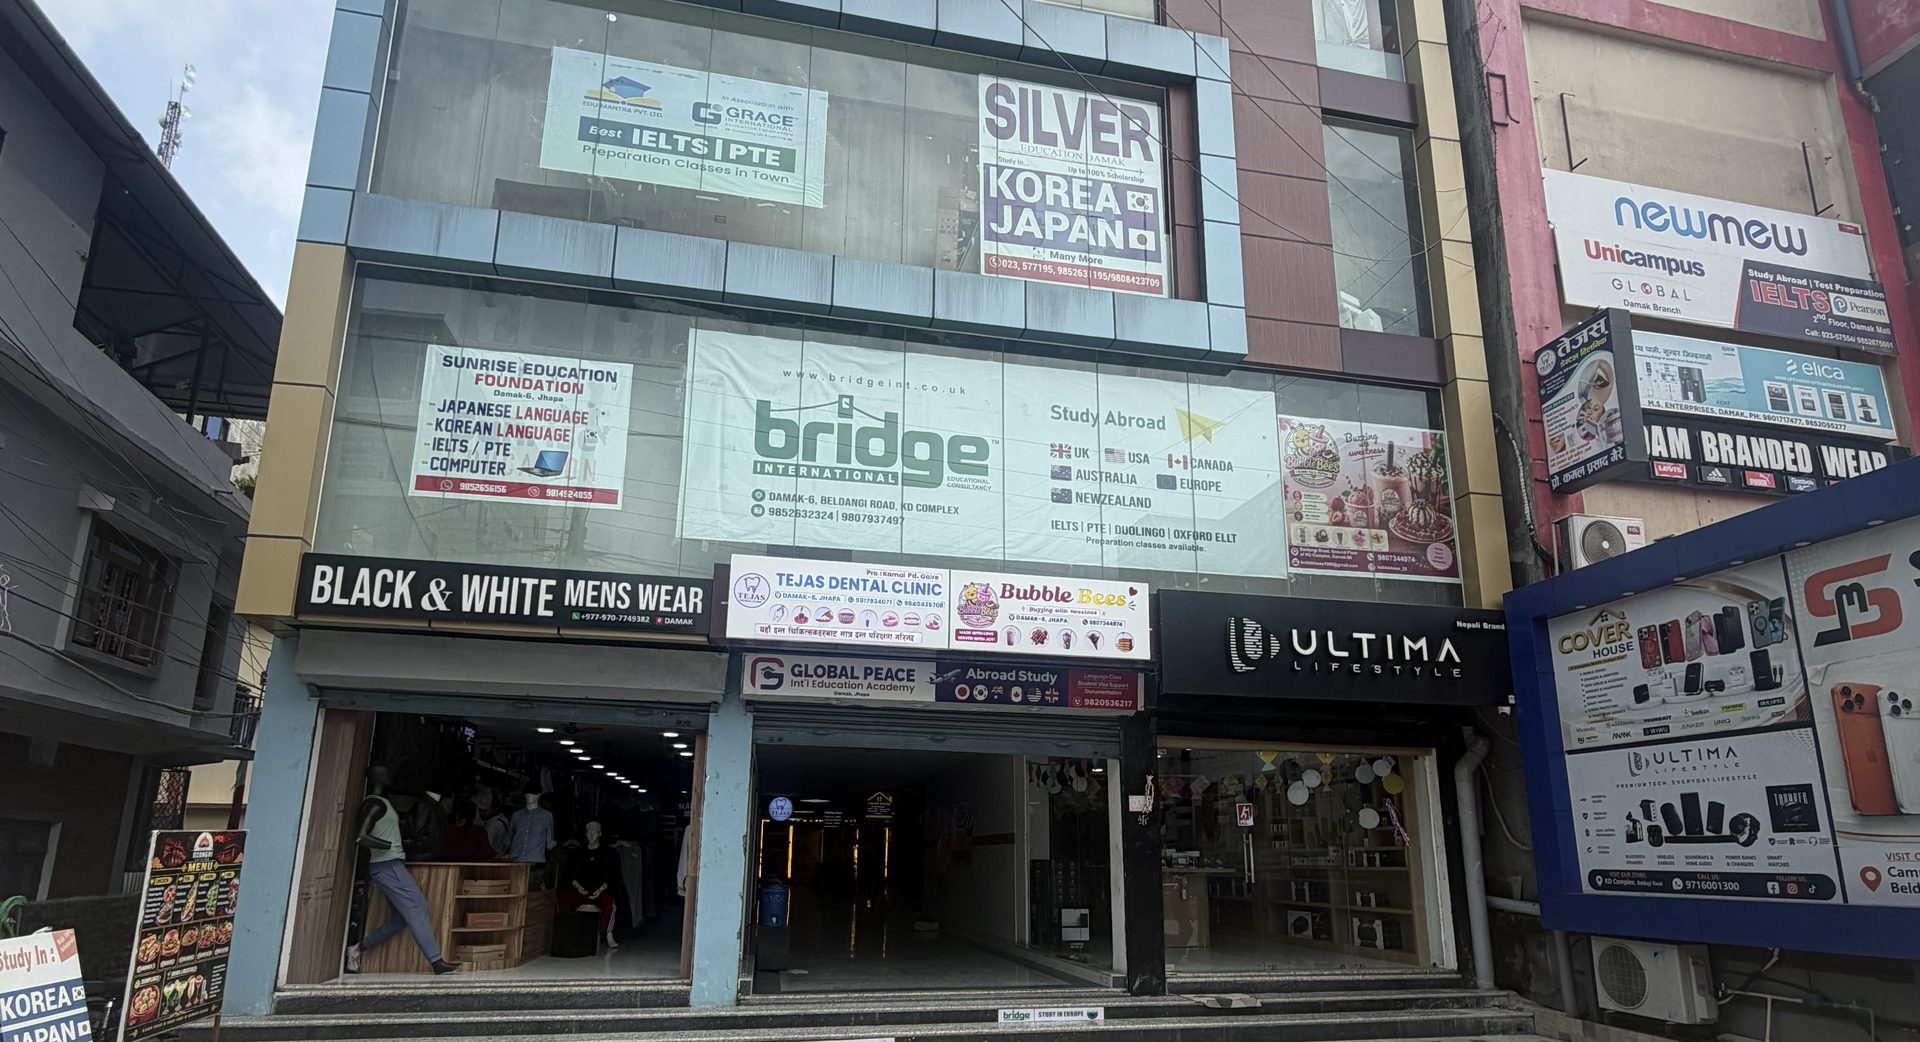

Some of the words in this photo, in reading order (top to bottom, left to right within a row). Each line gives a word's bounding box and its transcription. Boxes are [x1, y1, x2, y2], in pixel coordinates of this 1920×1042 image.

[731, 97, 776, 108] Association
[778, 103, 794, 111] with
[725, 117, 793, 132] INTERNATIONAL
[726, 106, 794, 127] GRACE
[985, 82, 1154, 162] SILVER
[589, 125, 623, 139] Best
[632, 128, 708, 155] IELTS
[729, 146, 780, 167] PTE
[1020, 143, 1083, 160] EDUCATION
[582, 144, 671, 167] Preparation
[675, 158, 732, 175] Classes
[735, 166, 748, 178] in
[752, 169, 790, 184] Town
[998, 156, 1016, 165] Study
[1068, 166, 1077, 175] Up
[1087, 168, 1105, 178] 100%
[1106, 171, 1145, 183] Scholarship
[989, 166, 1122, 215] KOREA
[989, 204, 1125, 250] JAPAN
[1614, 196, 1808, 257] newmew
[1001, 258, 1020, 270] 023,
[1022, 262, 1056, 275] 577195,
[1050, 250, 1076, 264] Many
[1078, 253, 1103, 266] More
[1584, 238, 1706, 277] Unicampus
[1611, 278, 1692, 301] GLOBAL
[1748, 268, 1774, 283] Study
[1776, 273, 1808, 287] Abroad
[1813, 280, 1834, 291] Test
[1835, 284, 1886, 299] Preparation
[1623, 299, 1651, 311] Damak
[1652, 303, 1682, 315] Branch
[1749, 279, 1831, 314] IELTS
[1850, 302, 1886, 317] Pearson
[1828, 317, 1850, 329] Floor,
[1850, 321, 1875, 333] Damak
[442, 355, 517, 373] SUNRISE
[523, 363, 618, 383] EDUCATION
[1801, 361, 1845, 380] elica
[475, 373, 584, 394] FOUNDATION
[782, 368, 967, 395] www.bridgeint.co.uk
[537, 393, 564, 403] Jhapa
[437, 399, 512, 418] JAPANESE
[515, 405, 589, 426] LANGUAGE
[1050, 404, 1099, 428] Study
[1104, 410, 1166, 431] Abroad
[1664, 401, 1717, 415] ENTERPRISES,
[1718, 408, 1748, 419] DAMAK,
[434, 418, 493, 437] KOREAN
[496, 424, 571, 443] LANGUAGE
[431, 437, 468, 454] IELTS
[484, 441, 511, 457] PTE
[754, 393, 991, 489] bridge
[1074, 447, 1090, 459] UK
[1128, 452, 1150, 465] USA
[1190, 457, 1234, 473] CANADA
[1700, 431, 1813, 474] BRANDED
[429, 456, 506, 476] COMPUTER
[756, 462, 896, 484] INTERNATIONAL
[1316, 459, 1340, 473] Bees
[946, 475, 991, 485] EDUCATIONAL
[946, 482, 992, 492] CONSULTANCY
[1075, 469, 1138, 485] AUSTRALIA
[1180, 478, 1222, 493] EUROPE
[768, 491, 819, 506] DAMAK-6,
[820, 495, 868, 510] BELDANGI
[869, 499, 898, 512] ROAD,
[900, 501, 914, 512] KD
[915, 502, 960, 516] COMPLEX
[1075, 491, 1152, 509] NEWZEALAND
[767, 506, 834, 521] 9852632324
[841, 511, 906, 526] 9807937497
[1051, 520, 1079, 532] IELTS
[1087, 522, 1107, 534] PTE
[1114, 525, 1165, 539] DUOLINGO
[1173, 529, 1213, 542] OXFORD
[1215, 532, 1237, 544] ELLT
[1085, 536, 1134, 548] Preparation
[1135, 540, 1167, 550] classes
[1168, 541, 1207, 552] available.
[310, 564, 418, 609] BLACK
[420, 577, 453, 613] &
[461, 573, 558, 617] WHITE
[563, 578, 632, 610] MENS
[638, 584, 703, 614] WEAR
[776, 573, 824, 588] TEJAS
[828, 576, 888, 593] DENTAL
[891, 580, 942, 596] CLINIC
[738, 592, 766, 601] TEJAS
[819, 594, 841, 602] JHAPA
[1000, 582, 1074, 603] Bubble
[1077, 588, 1127, 607] Bees
[664, 616, 694, 626] DAMAK
[1456, 620, 1481, 631] Nepali
[1482, 622, 1505, 631] Brand
[1291, 628, 1461, 663] ULTIMA
[1558, 621, 1633, 654] COVER
[1593, 641, 1635, 659] HOUSE
[790, 663, 859, 680] GLOBAL
[863, 666, 916, 682] PEACE
[965, 668, 1016, 681] Abroad
[1018, 670, 1058, 686] Study
[1294, 661, 1462, 678] LIFESTYLE
[811, 679, 864, 690] Education
[865, 682, 915, 694] Academy
[1690, 708, 1710, 717] belkin
[1653, 746, 1738, 765] ULTIMA
[1655, 761, 1740, 774] LIFESTYLE
[1885, 852, 1910, 861] VISIT
[187, 862, 213, 872] MENU
[1887, 866, 1920, 878] Cam
[1685, 880, 1740, 891] 9716001300
[35, 945, 48, 965] In
[0, 986, 72, 1021] KOREA
[1003, 1010, 1030, 1020] bridge
